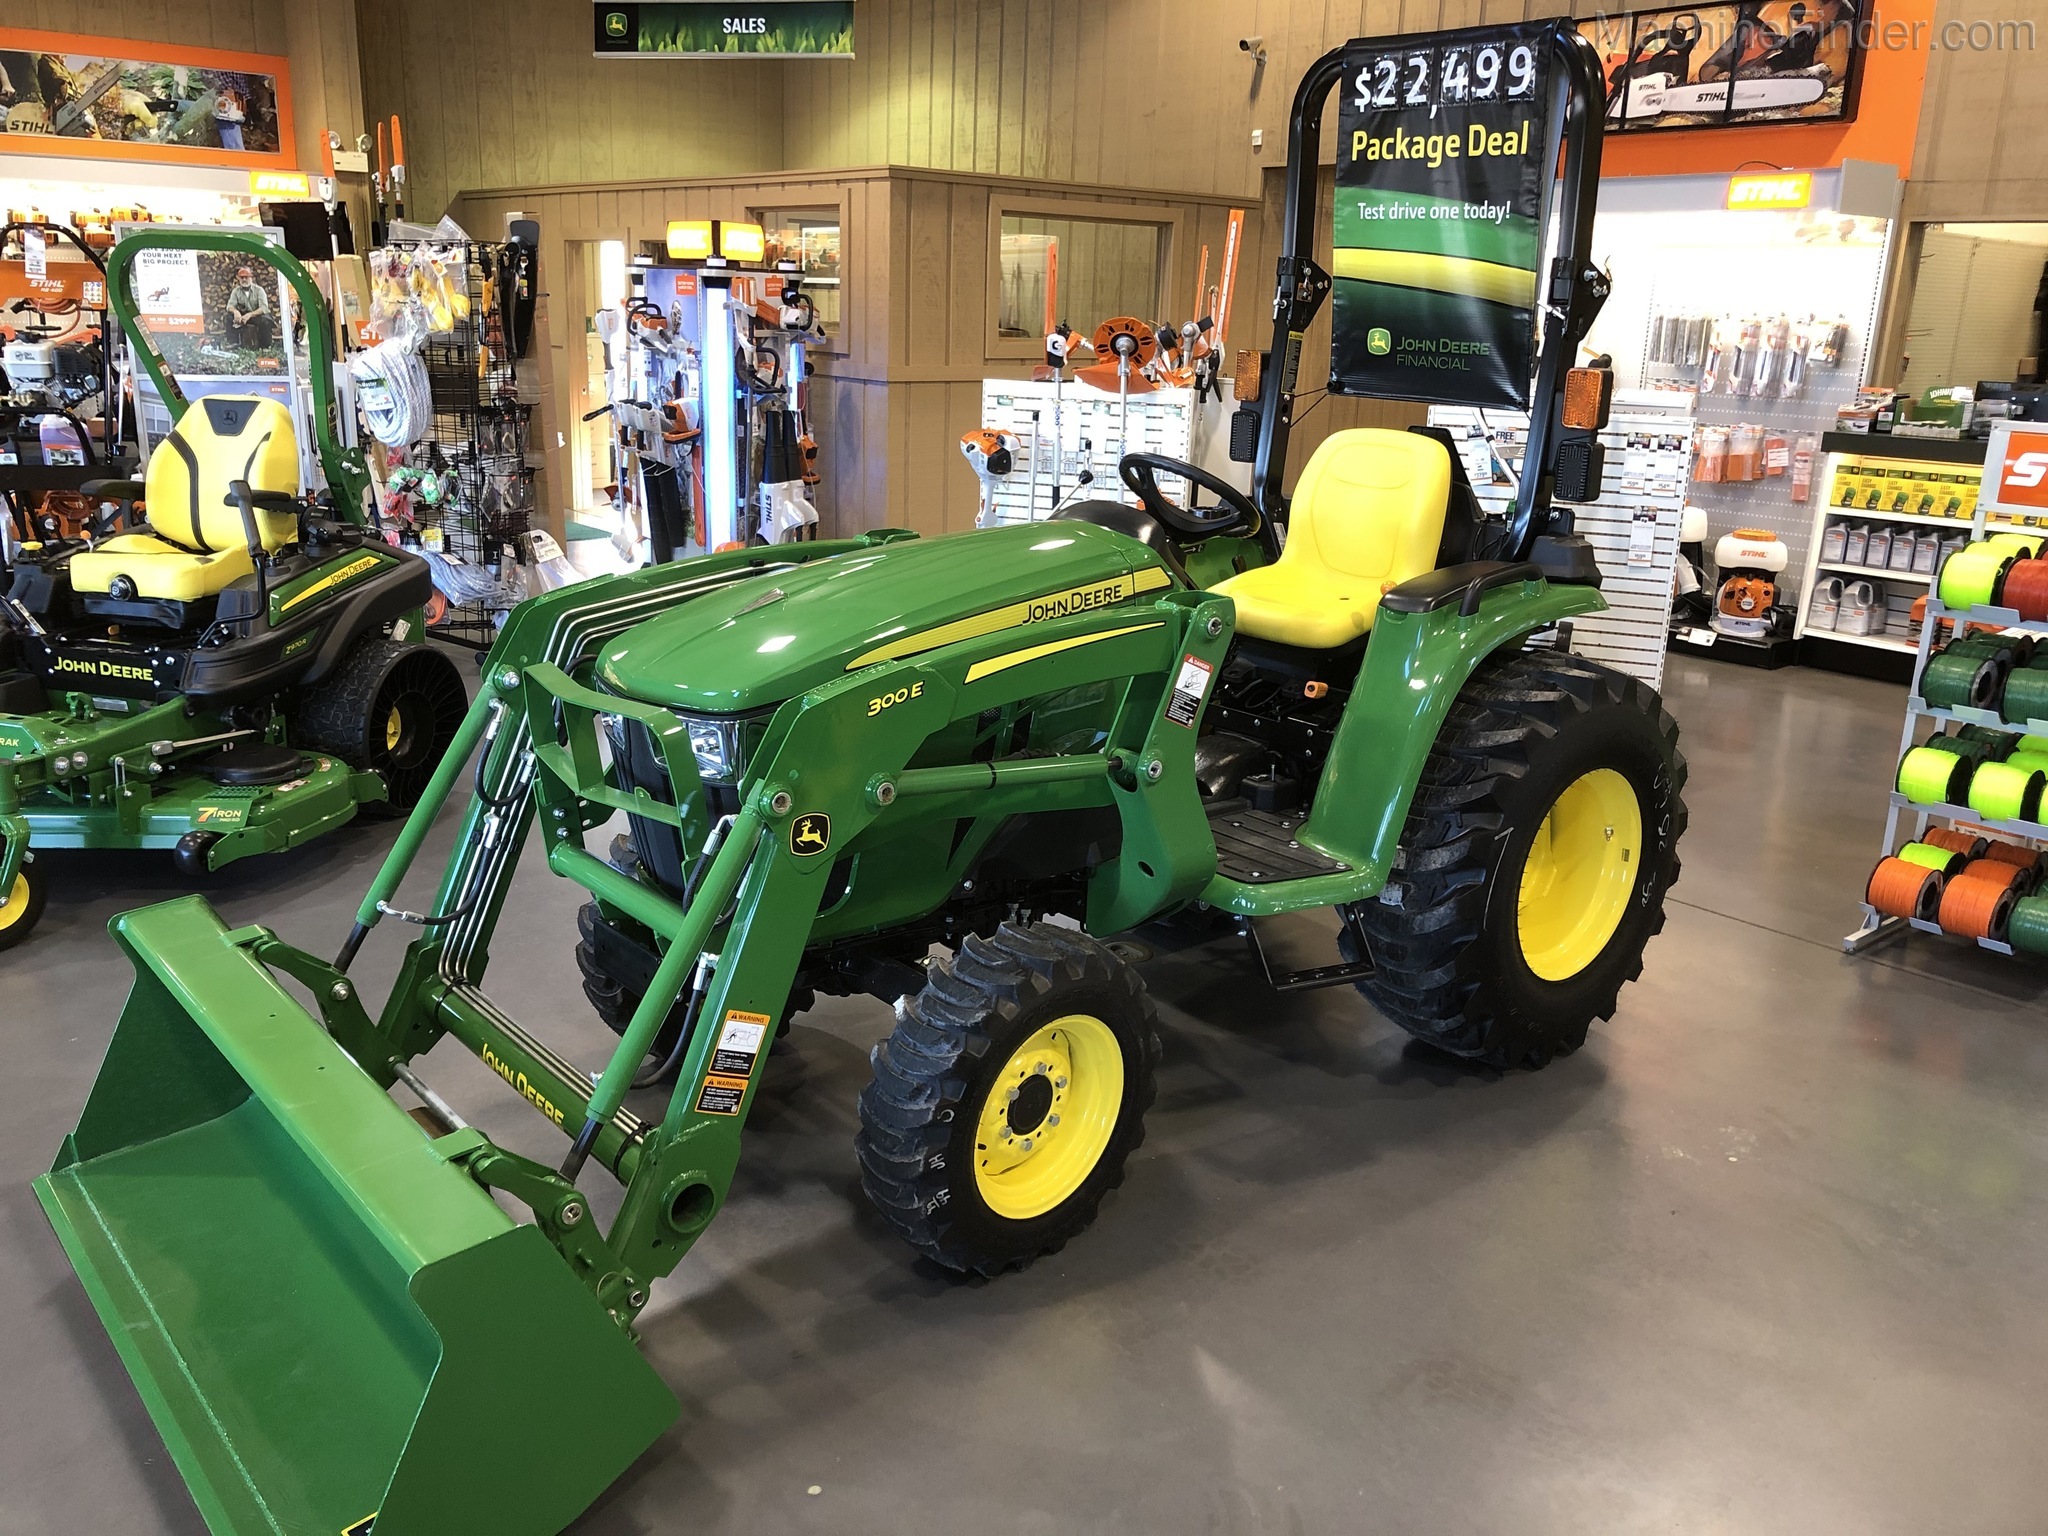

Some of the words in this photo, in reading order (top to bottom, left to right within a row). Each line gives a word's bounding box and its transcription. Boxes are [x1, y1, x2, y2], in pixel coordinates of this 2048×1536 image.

[723, 18, 766, 33] SALES
[1354, 46, 1533, 119] $22,499
[1696, 92, 1727, 103] STIHL
[10, 120, 53, 135] STIHL
[1352, 128, 1460, 168] Package
[1468, 120, 1530, 157] Deal
[1358, 203, 1385, 219] Test
[1389, 202, 1426, 219] drive
[1430, 205, 1459, 219] one
[1463, 201, 1511, 224] today!
[1396, 336, 1436, 352] JOHN
[1439, 339, 1491, 356] DEERE
[1396, 354, 1470, 371] FINANCIAL
[1496, 431, 1515, 440] FREE
[765, 494, 773, 524] STIHL
[1740, 550, 1768, 558] STIHL
[331, 570, 348, 585] JOHN
[348, 559, 372, 575] DEERE
[1023, 598, 1069, 625] JOHN
[1071, 585, 1123, 611] DEERE
[54, 657, 97, 674] JOHN
[100, 661, 154, 681] DEERE
[1193, 660, 1210, 670] DANGER
[738, 1014, 765, 1023] WARNING
[482, 1043, 514, 1086] JOHN
[716, 1080, 743, 1088] WARNING
